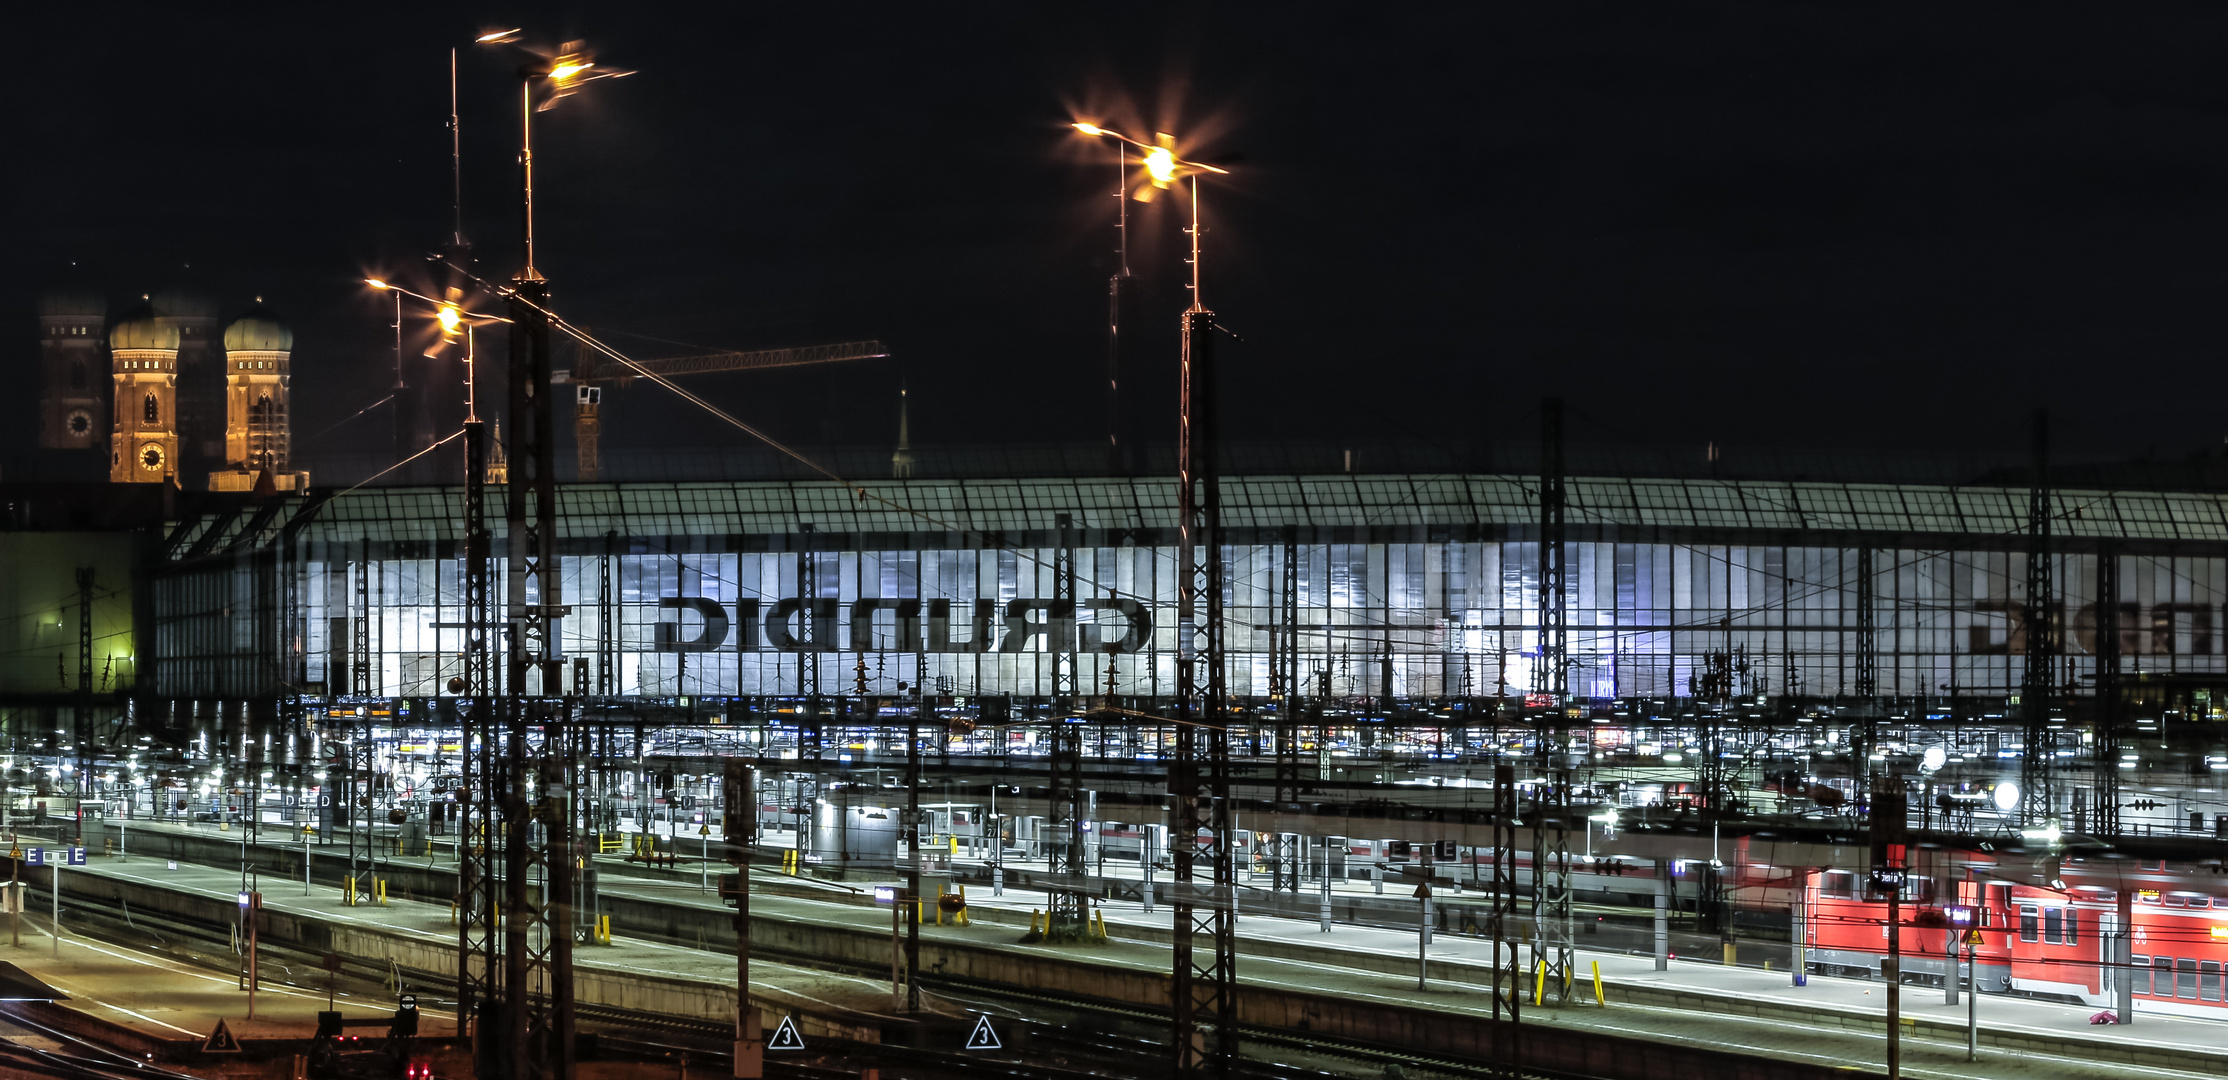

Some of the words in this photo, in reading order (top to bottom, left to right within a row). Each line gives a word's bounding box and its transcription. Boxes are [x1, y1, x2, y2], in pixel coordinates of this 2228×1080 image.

[286, 794, 295, 806] D
[321, 795, 330, 807] D
[27, 848, 37, 862] E
[74, 847, 84, 862] E
[1443, 841, 1454, 857] E
[217, 1033, 227, 1048] 3
[782, 1026, 791, 1045] 3
[979, 1026, 988, 1044] 3
